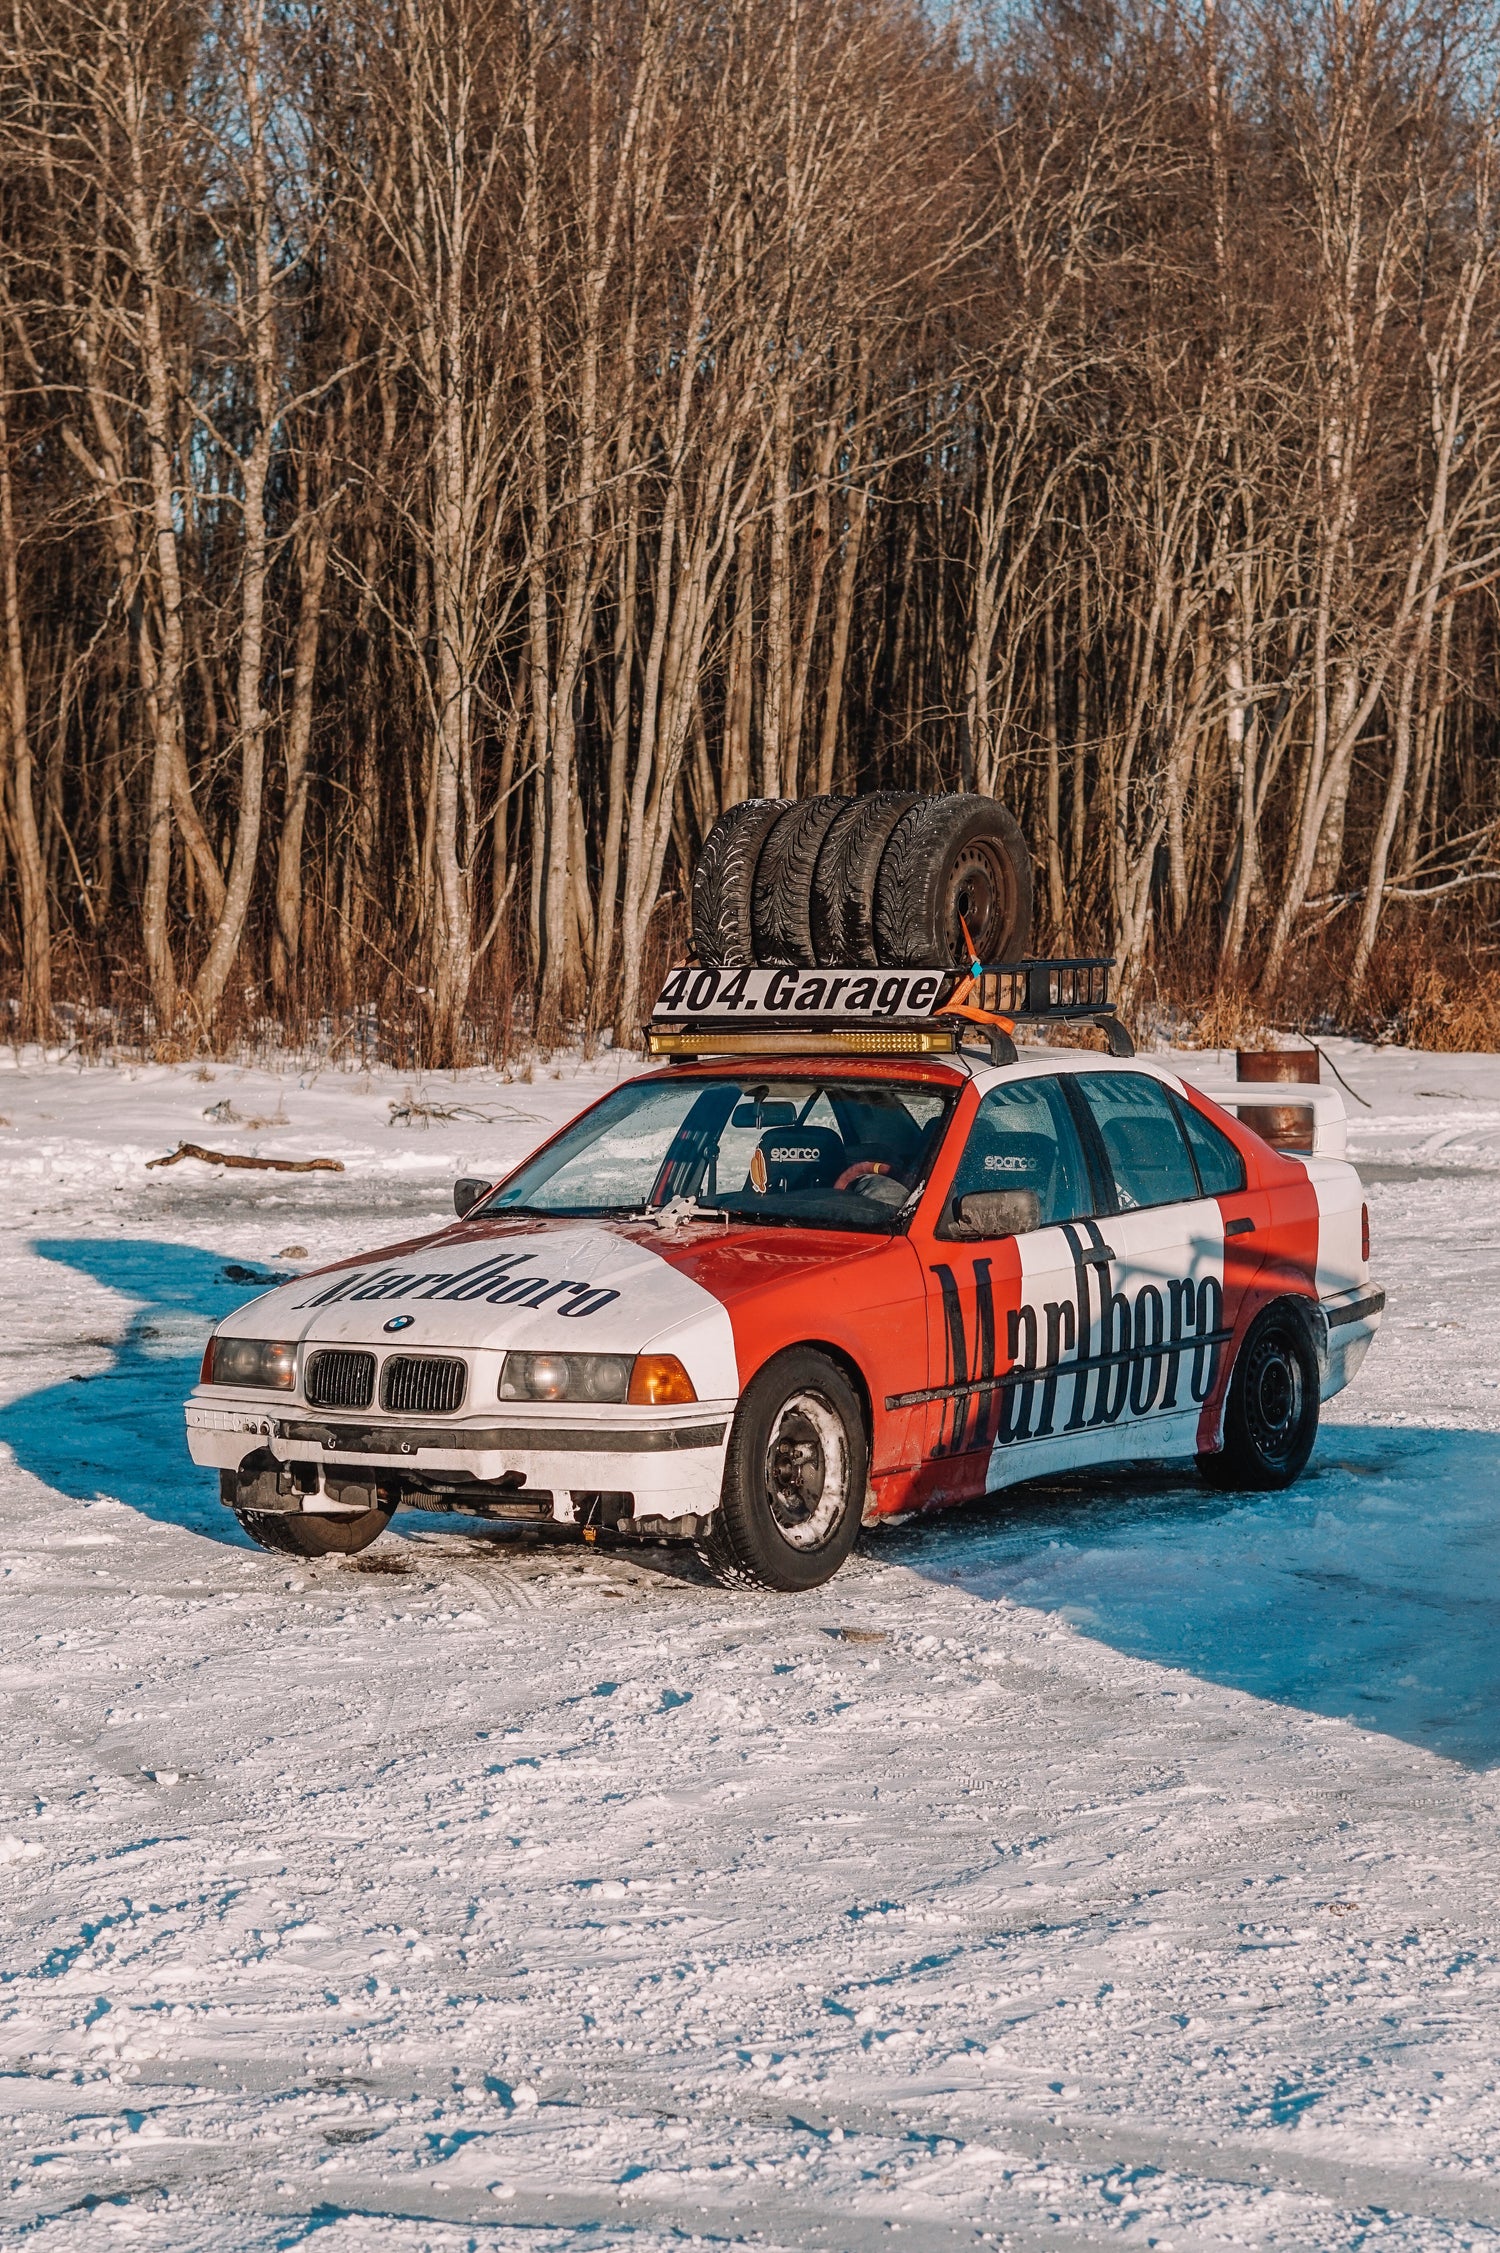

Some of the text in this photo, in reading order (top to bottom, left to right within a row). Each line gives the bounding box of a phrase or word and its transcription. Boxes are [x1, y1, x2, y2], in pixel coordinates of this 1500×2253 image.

[657, 968, 938, 1016] 404.Garage
[770, 1147, 821, 1162] sparco
[985, 1155, 1037, 1171] sparco
[291, 1253, 621, 1318] Marlboro
[930, 1220, 1223, 1457] Marlboro
